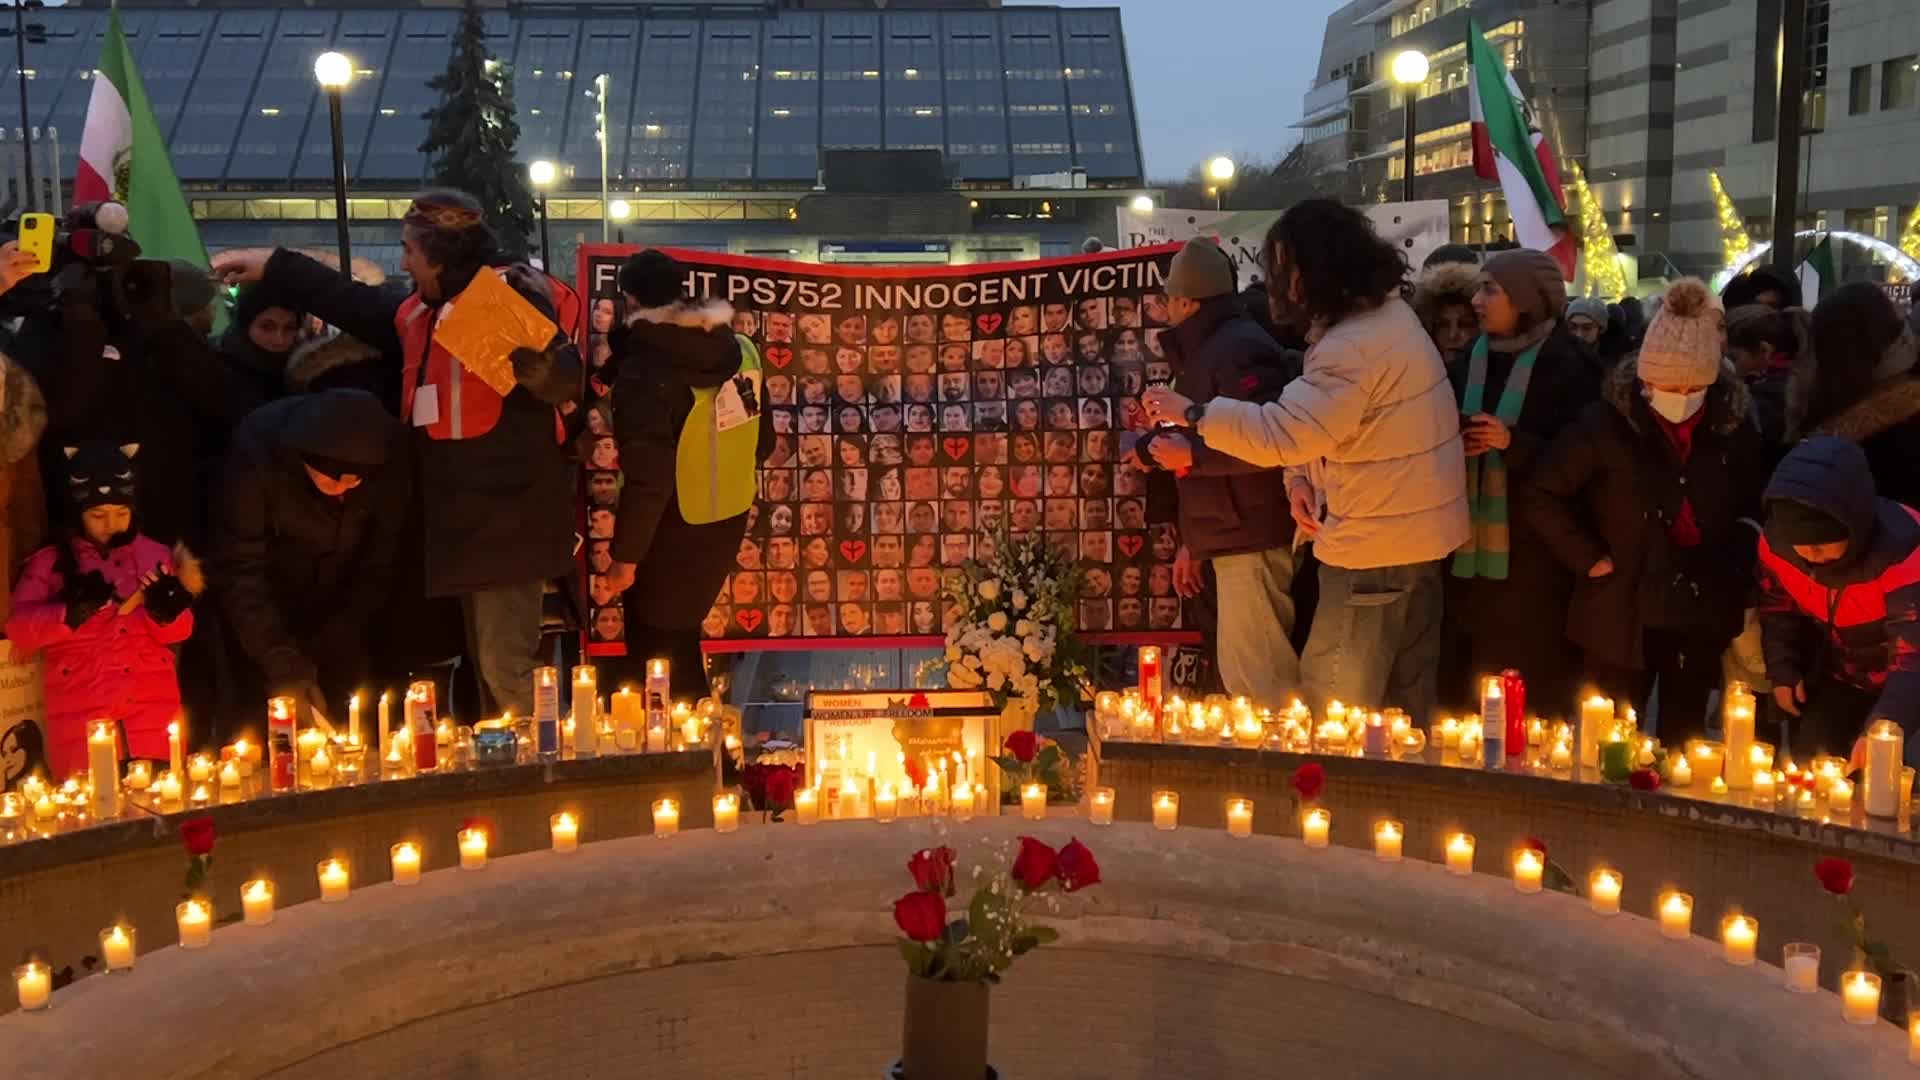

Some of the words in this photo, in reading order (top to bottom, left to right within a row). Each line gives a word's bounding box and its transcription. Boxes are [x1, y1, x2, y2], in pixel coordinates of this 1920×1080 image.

[596, 264, 717, 299] FHT
[728, 275, 842, 309] PS752
[855, 273, 1048, 310] INNOCENT
[1057, 260, 1168, 295] VICTIM
[823, 699, 860, 708] WOMEN
